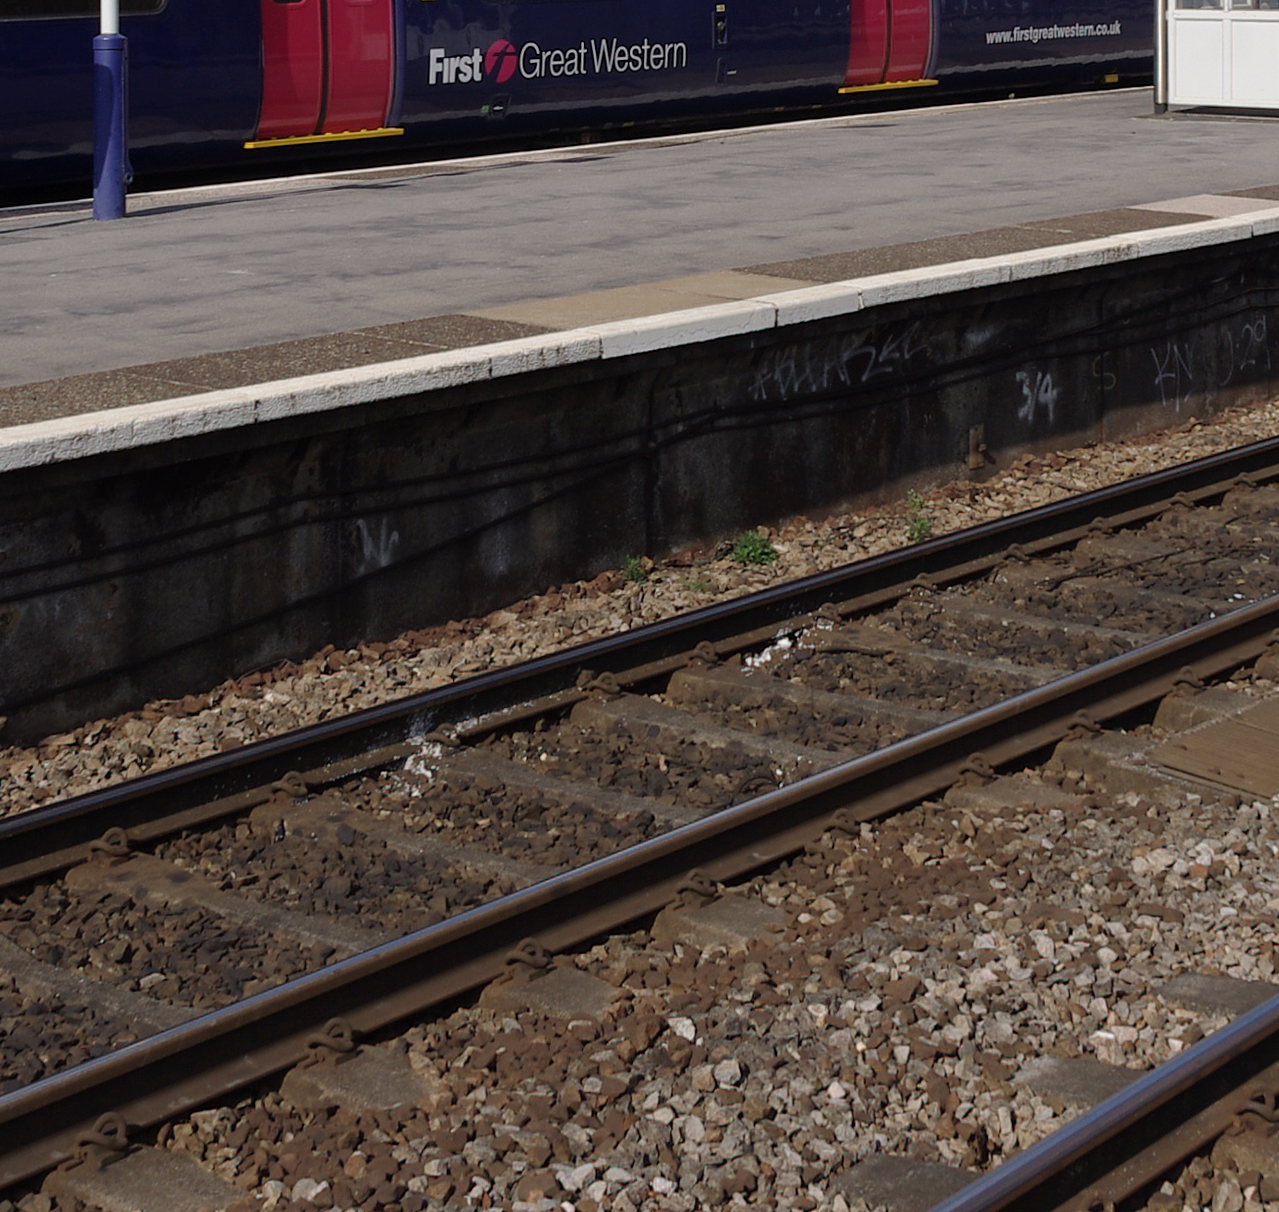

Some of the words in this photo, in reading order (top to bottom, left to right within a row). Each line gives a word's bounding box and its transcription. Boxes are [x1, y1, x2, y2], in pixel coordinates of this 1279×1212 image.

[985, 19, 1122, 45] www.firstgreatwestern.co.uk
[428, 47, 483, 85] First
[519, 40, 587, 79] Great
[590, 36, 687, 74] Western
